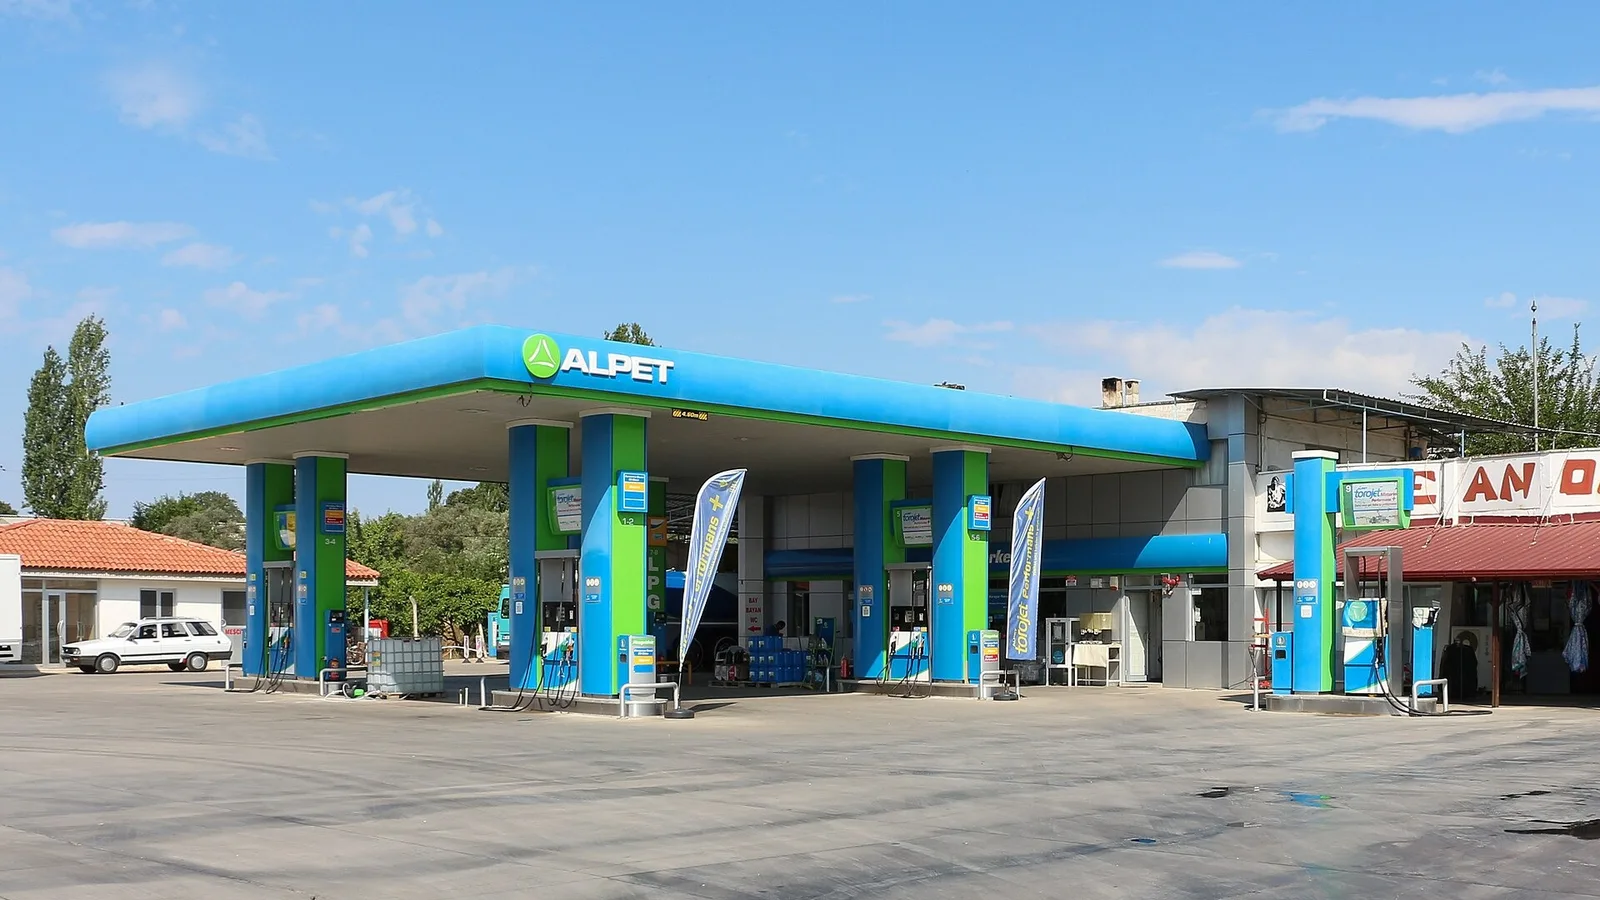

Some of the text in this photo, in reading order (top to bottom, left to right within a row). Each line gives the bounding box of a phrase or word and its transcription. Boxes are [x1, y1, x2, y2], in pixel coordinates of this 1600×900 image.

[560, 348, 675, 383] ALPET
[1560, 459, 1600, 495] O
[694, 516, 719, 593] erformans
[989, 550, 1011, 564] rke
[1015, 601, 1031, 654] torojet
